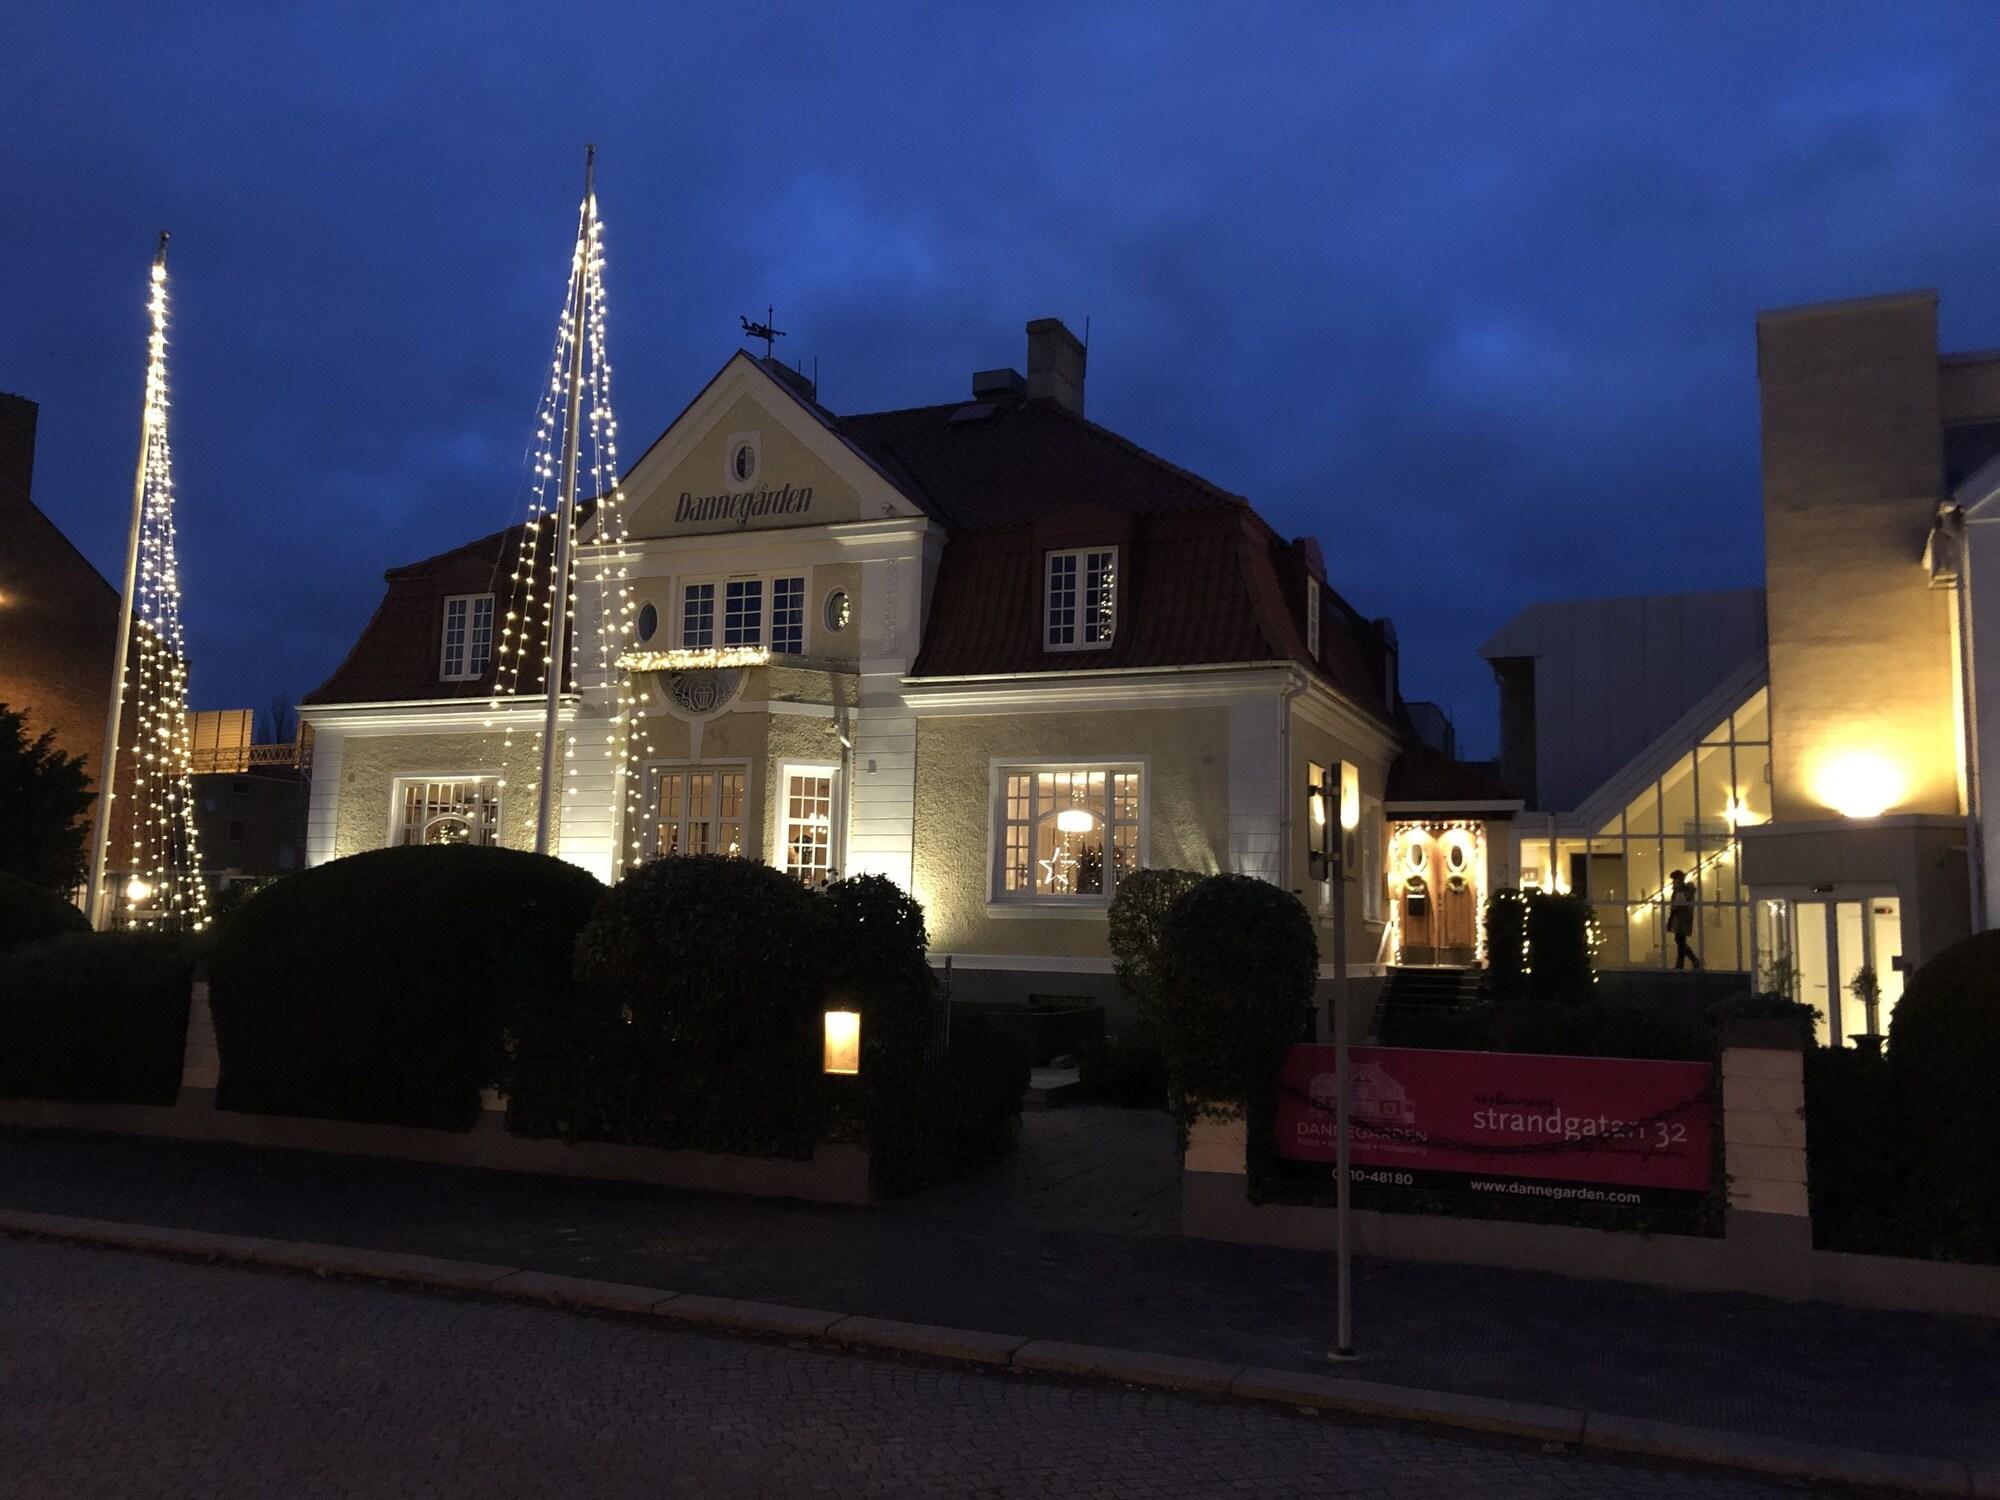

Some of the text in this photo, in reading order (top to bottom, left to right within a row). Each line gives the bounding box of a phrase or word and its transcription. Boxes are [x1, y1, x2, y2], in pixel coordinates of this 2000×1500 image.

[674, 483, 813, 529] Dannegården
[1655, 1122, 1688, 1148] 32
[1331, 1168, 1414, 1186] 010-48180
[1470, 1181, 1641, 1205] www.dannegarden.com
